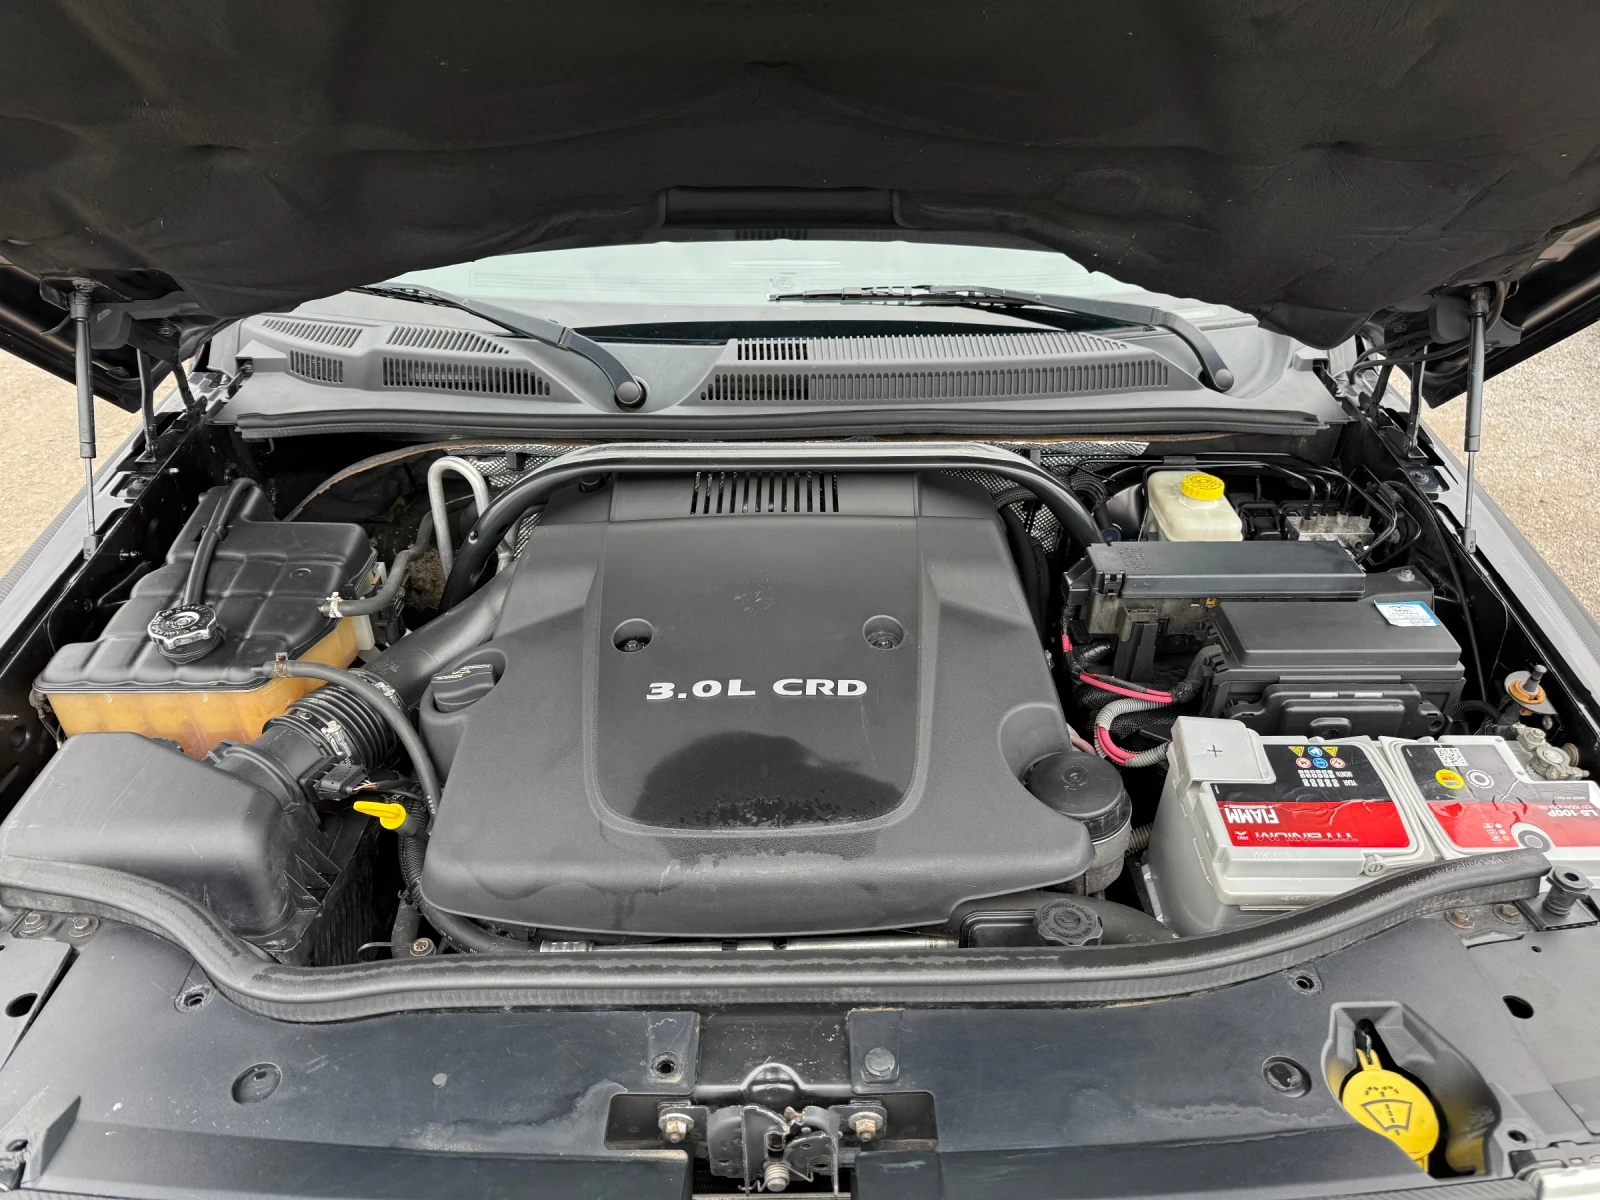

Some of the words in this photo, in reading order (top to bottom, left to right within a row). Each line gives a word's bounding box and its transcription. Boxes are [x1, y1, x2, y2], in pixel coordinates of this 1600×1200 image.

[646, 679, 756, 700] 3.0L
[772, 678, 868, 696] CRD
[1224, 807, 1279, 824] FIAMM
[1547, 809, 1579, 817] 100P
